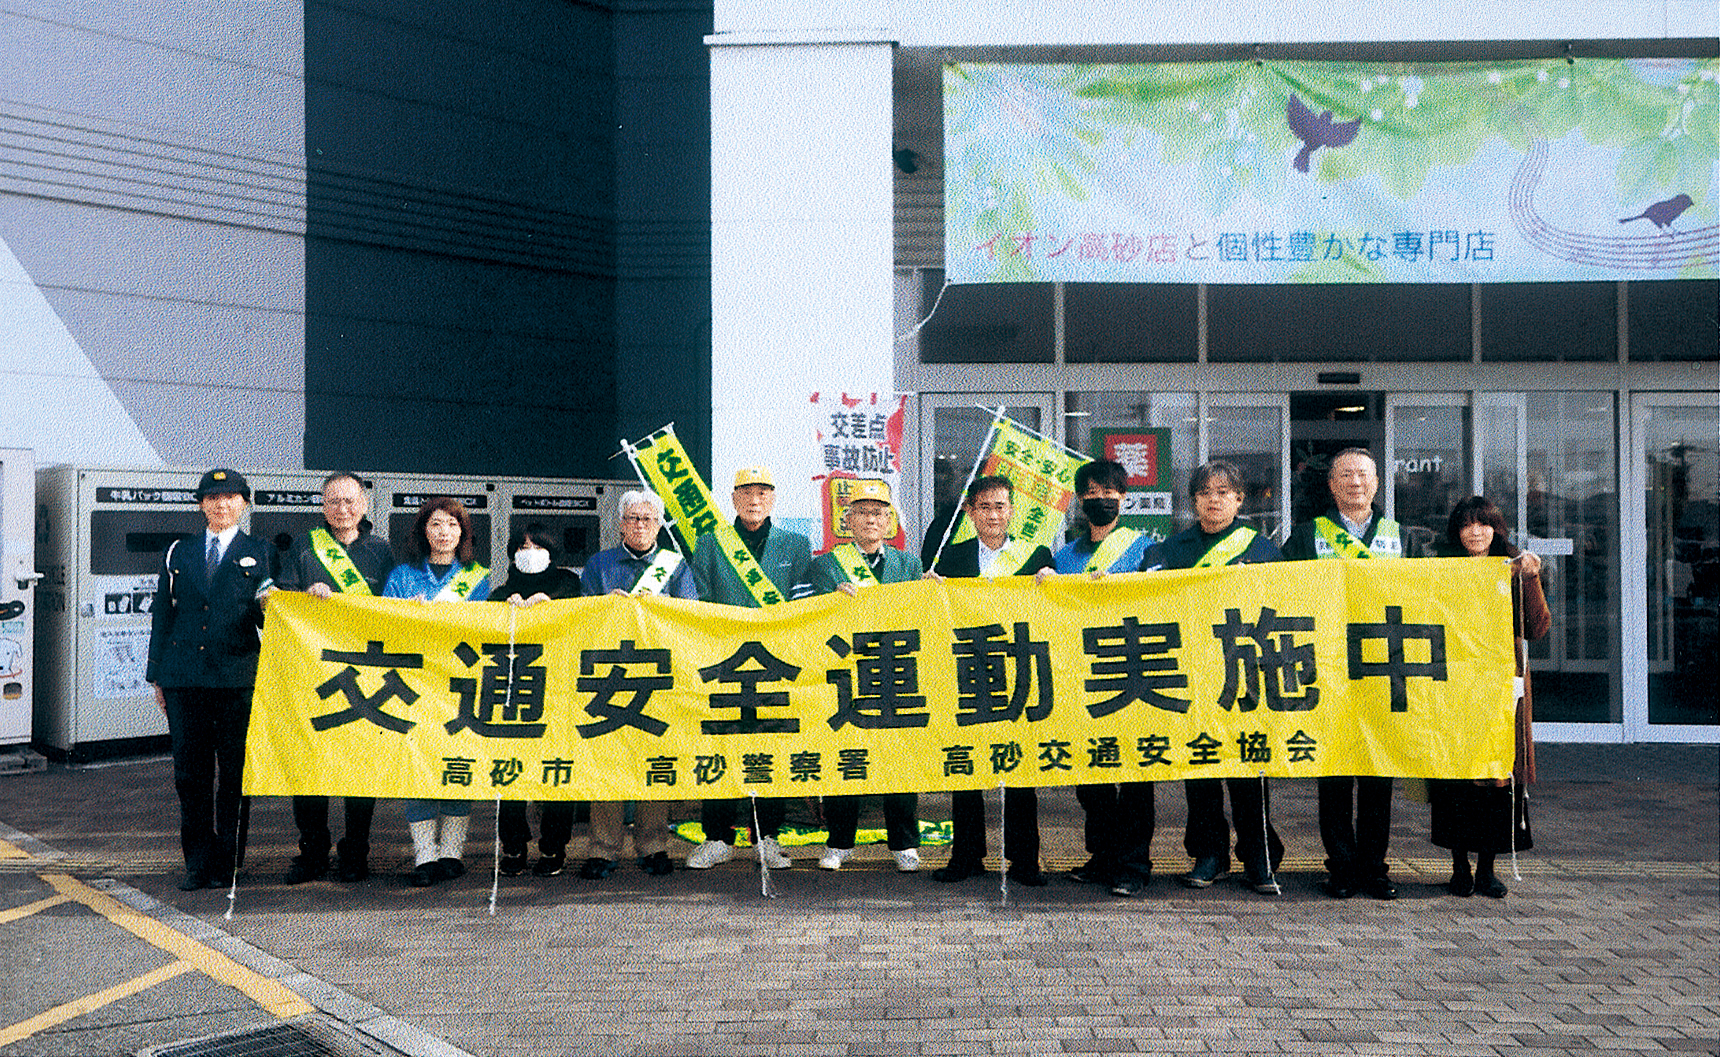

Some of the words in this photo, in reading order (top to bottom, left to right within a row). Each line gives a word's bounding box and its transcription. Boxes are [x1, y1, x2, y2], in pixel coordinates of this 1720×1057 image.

[976, 229, 1496, 264] イオン高砂店と個性豊かな専門店
[830, 411, 886, 440] 交差点
[823, 444, 895, 474] 事故防止
[309, 604, 1449, 741] 交通安全運動実施中
[440, 756, 575, 788] 高砂市
[645, 748, 872, 787] 高砂警察署
[941, 730, 1319, 777] 高砂交通安全協会
